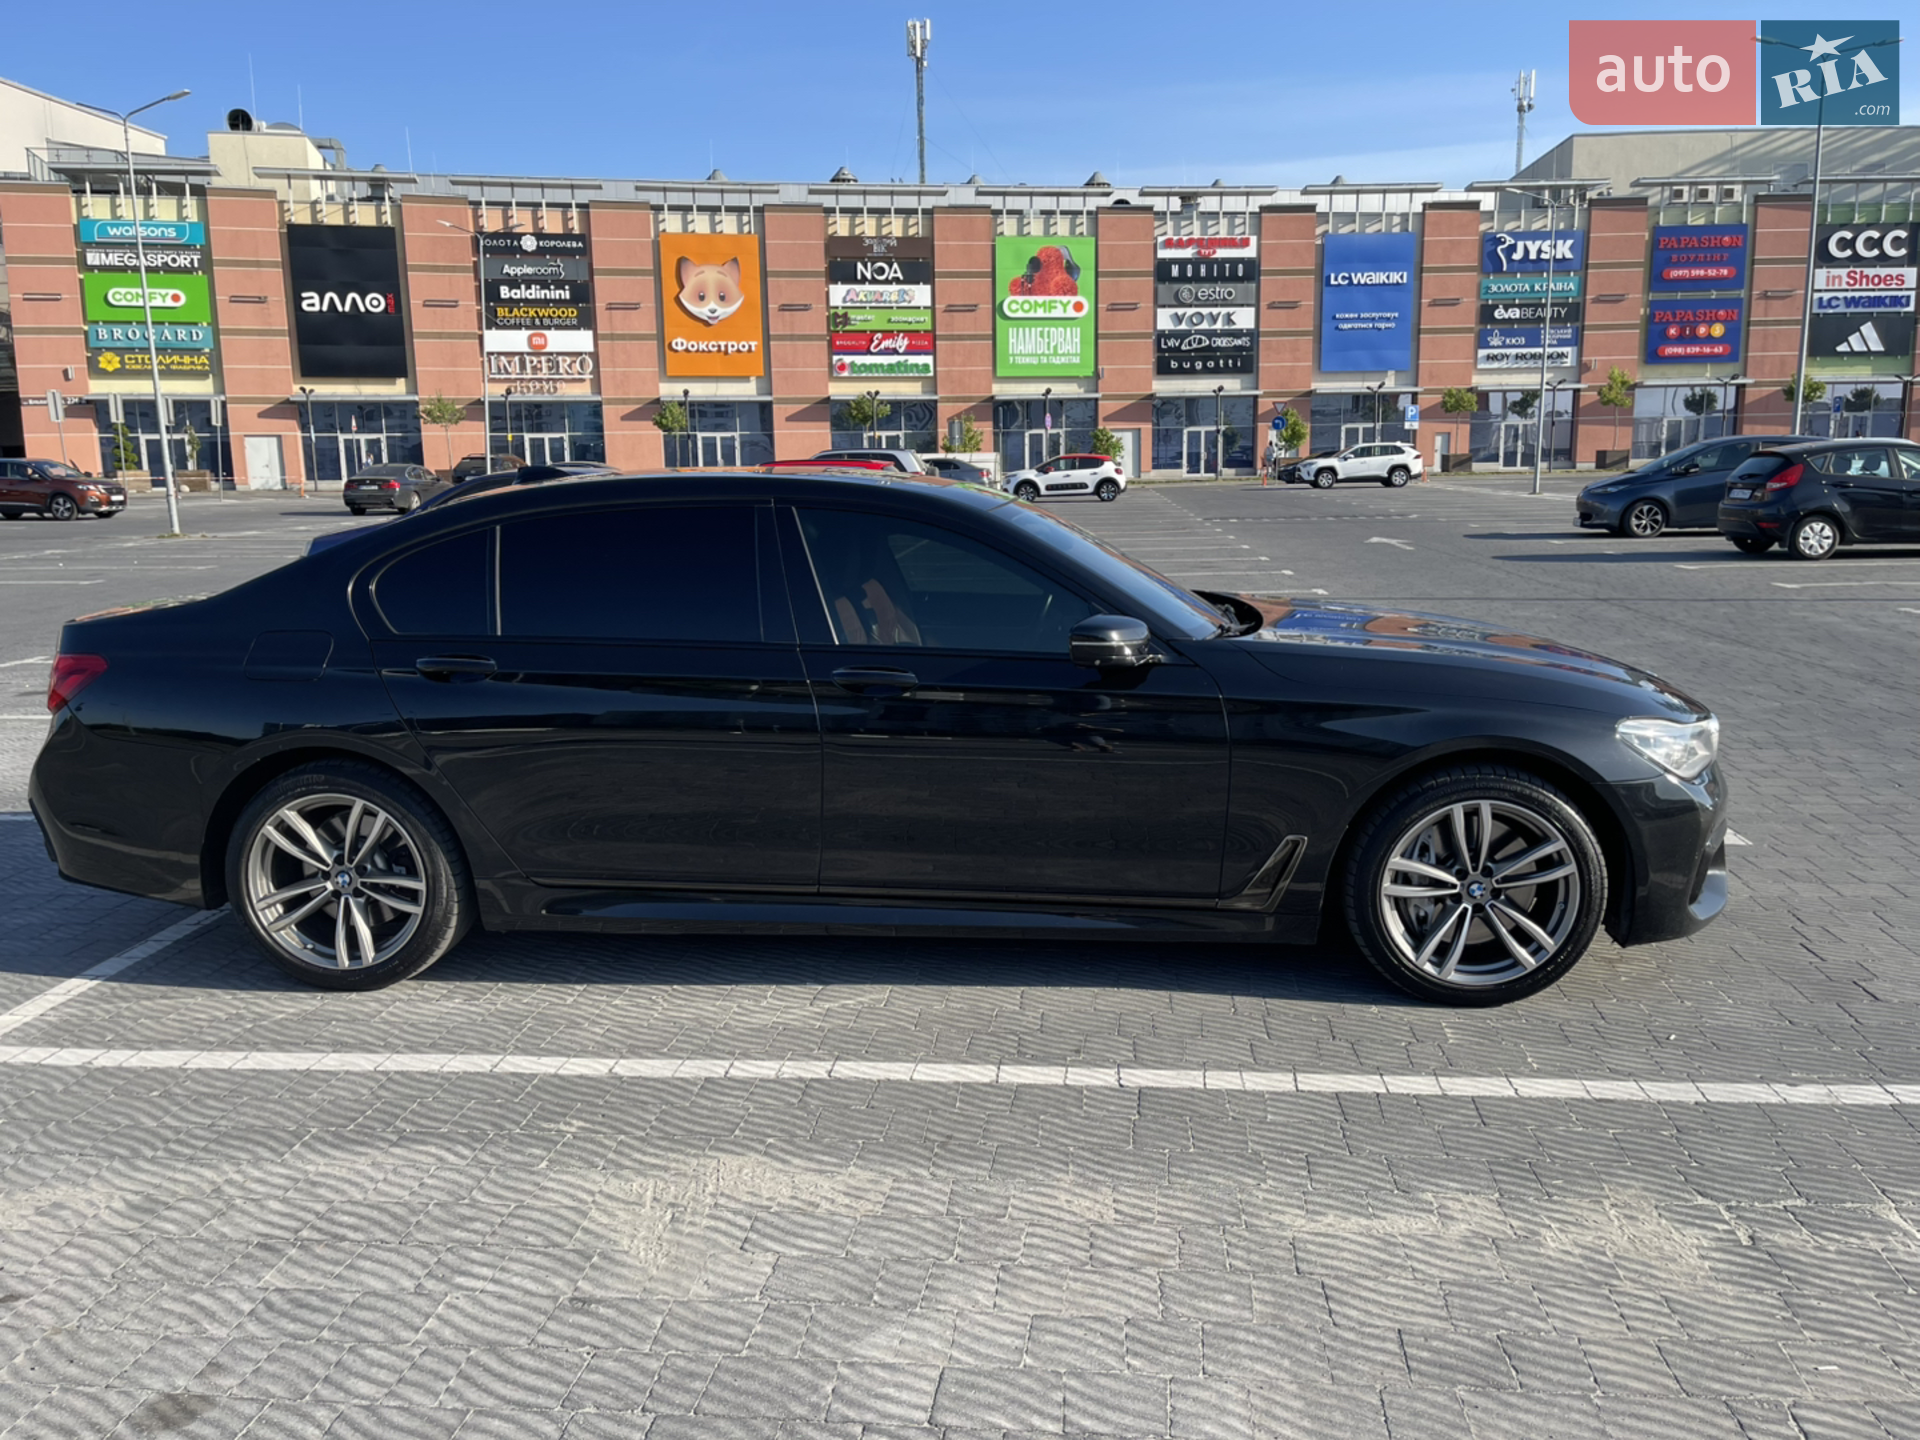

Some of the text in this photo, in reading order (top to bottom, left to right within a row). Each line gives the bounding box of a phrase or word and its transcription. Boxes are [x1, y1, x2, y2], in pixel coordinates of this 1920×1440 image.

[1658, 235, 1744, 248] PAPASHON
[1828, 230, 1908, 258] CCC
[1511, 240, 1574, 260] JYSK
[101, 253, 201, 268] MEGASPORT
[857, 262, 903, 280] NOA
[1171, 264, 1244, 277] MOHITO
[1330, 272, 1349, 285] LC
[1845, 270, 1905, 287] Shoes
[499, 284, 570, 299] Baldinini
[1197, 286, 1236, 300] estro
[1488, 284, 1530, 293] ЗОЛОТА
[301, 292, 386, 313] алло
[1007, 299, 1071, 314] COMFY
[1818, 297, 1840, 310] LC
[496, 307, 578, 317] BLACKWOOD
[1170, 311, 1236, 328] VOVK
[1654, 309, 1739, 322] PAPASHON
[496, 318, 532, 326] COFFEE
[542, 318, 578, 326] BURGER
[98, 328, 203, 340] BROCARD
[1009, 327, 1080, 354] НАМБЕРВАН
[671, 336, 758, 354] Фокстрот
[870, 333, 909, 353] Emily
[489, 355, 594, 374] IMPERO
[1486, 353, 1511, 361] ROY
[850, 360, 931, 374] tomatina
